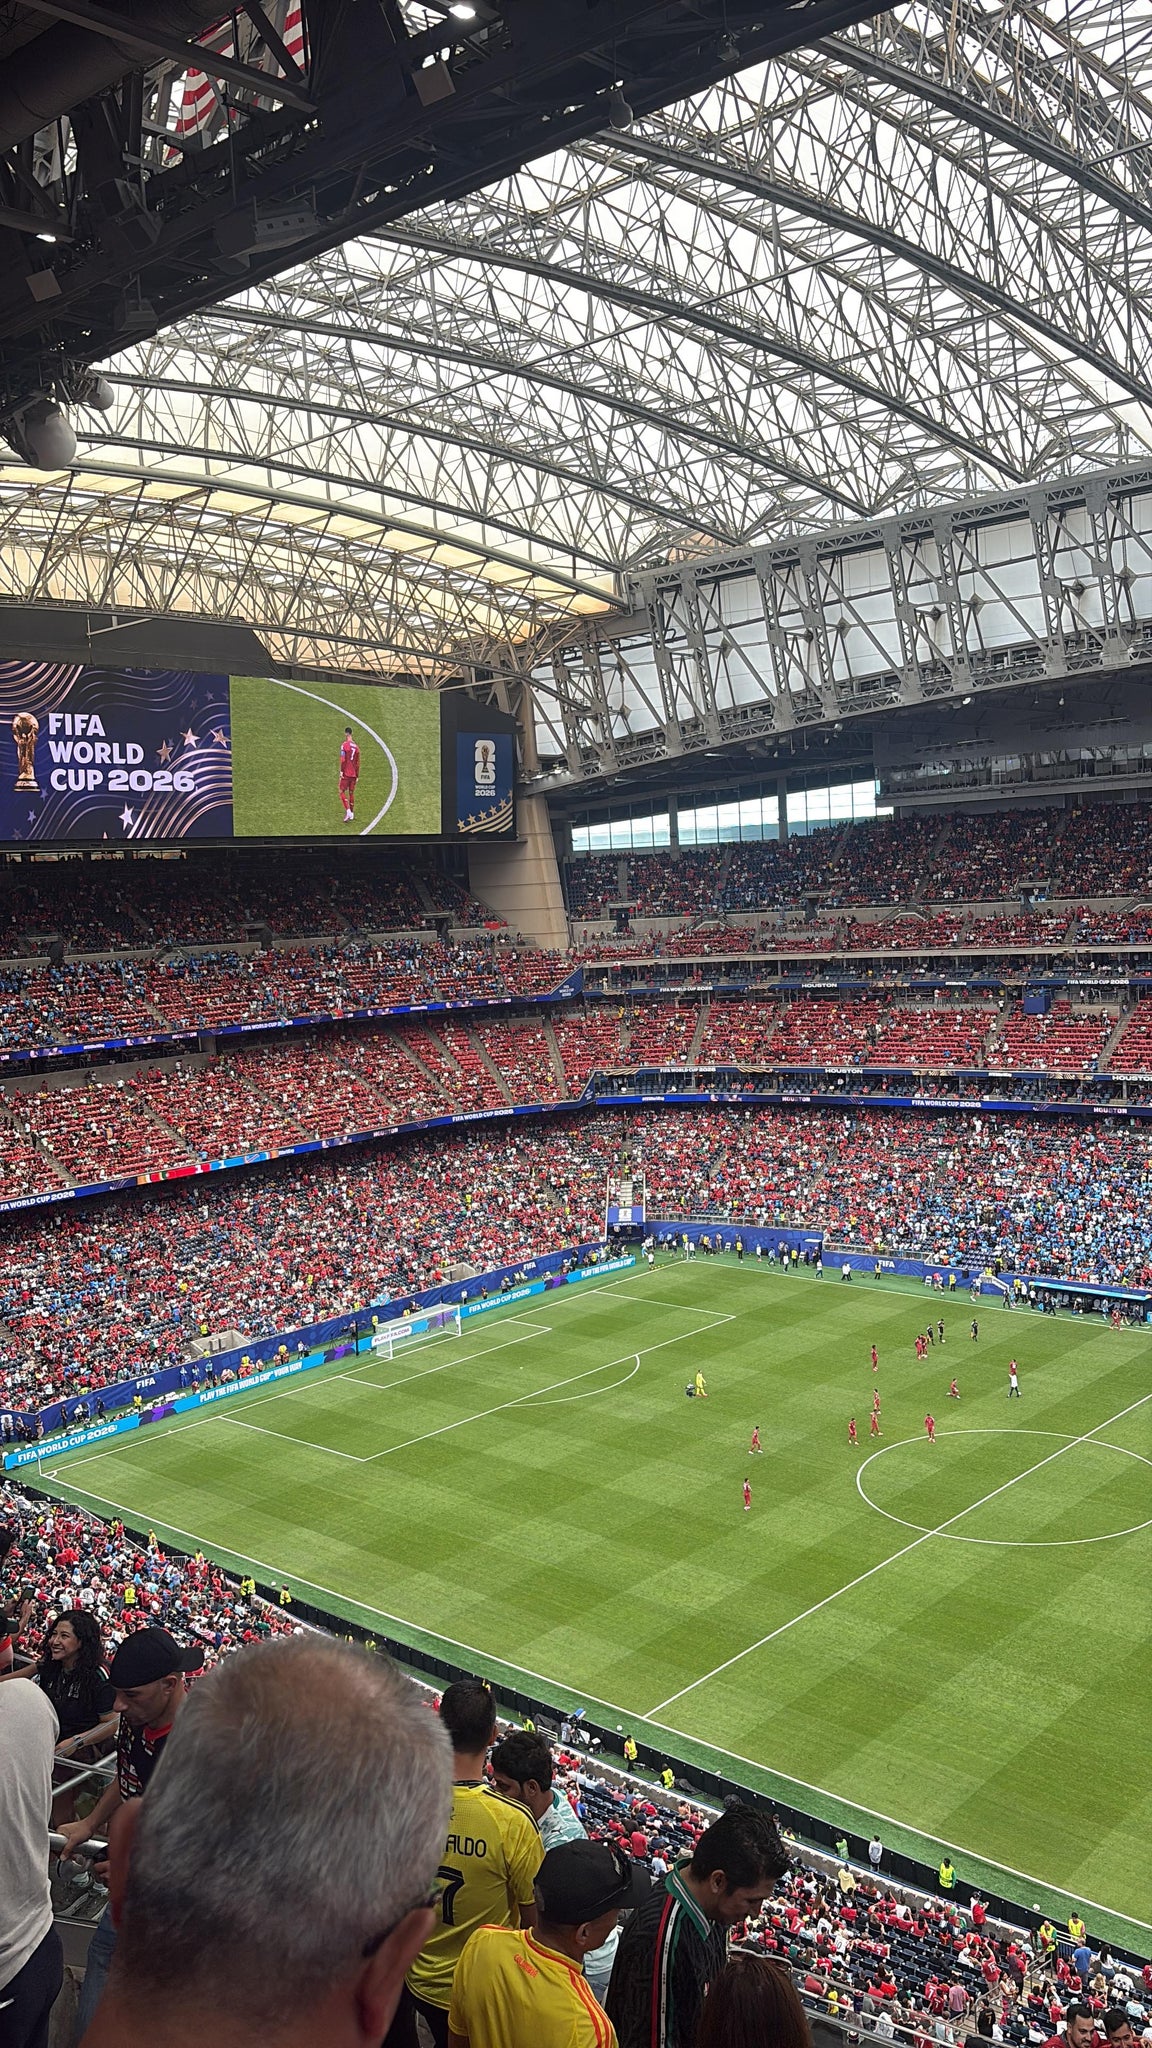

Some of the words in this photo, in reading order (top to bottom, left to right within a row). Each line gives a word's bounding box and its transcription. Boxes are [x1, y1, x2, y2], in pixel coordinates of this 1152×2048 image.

[49, 713, 106, 737] FIFA
[48, 741, 145, 765] WORLD
[350, 748, 356, 760] 7
[50, 768, 104, 792] CUP
[108, 769, 196, 792] 2026
[251, 1022, 268, 1030] WORLD
[464, 1113, 483, 1121] WORLD
[494, 1108, 514, 1116] 2026
[0, 1203, 10, 1211] FA
[9, 1198, 36, 1209] WORLD
[36, 1194, 50, 1203] CUP
[51, 1190, 76, 1201] 2026
[523, 1261, 537, 1271] FIFA
[581, 1268, 591, 1278] PLAY
[599, 1263, 609, 1273] FIFA
[608, 1260, 624, 1271] WORLD
[877, 1259, 896, 1269] FIFA
[468, 1304, 481, 1313] FIFA
[480, 1298, 501, 1309] WORLD
[500, 1294, 512, 1303] CUP
[511, 1288, 531, 1300] 2026
[136, 1377, 156, 1390] FIFA
[200, 1390, 215, 1403] PLAY
[215, 1386, 227, 1398] THE
[226, 1382, 239, 1394] FIFA
[238, 1376, 259, 1390] WORLD
[273, 1365, 289, 1378] YOUR
[289, 1361, 303, 1373] WAY
[17, 1450, 38, 1463] FIFA
[37, 1440, 69, 1457] WORLD
[69, 1434, 87, 1446] CUP
[87, 1424, 117, 1439] 2026
[446, 1834, 487, 1858] ALDO
[435, 1865, 465, 1926] 7
